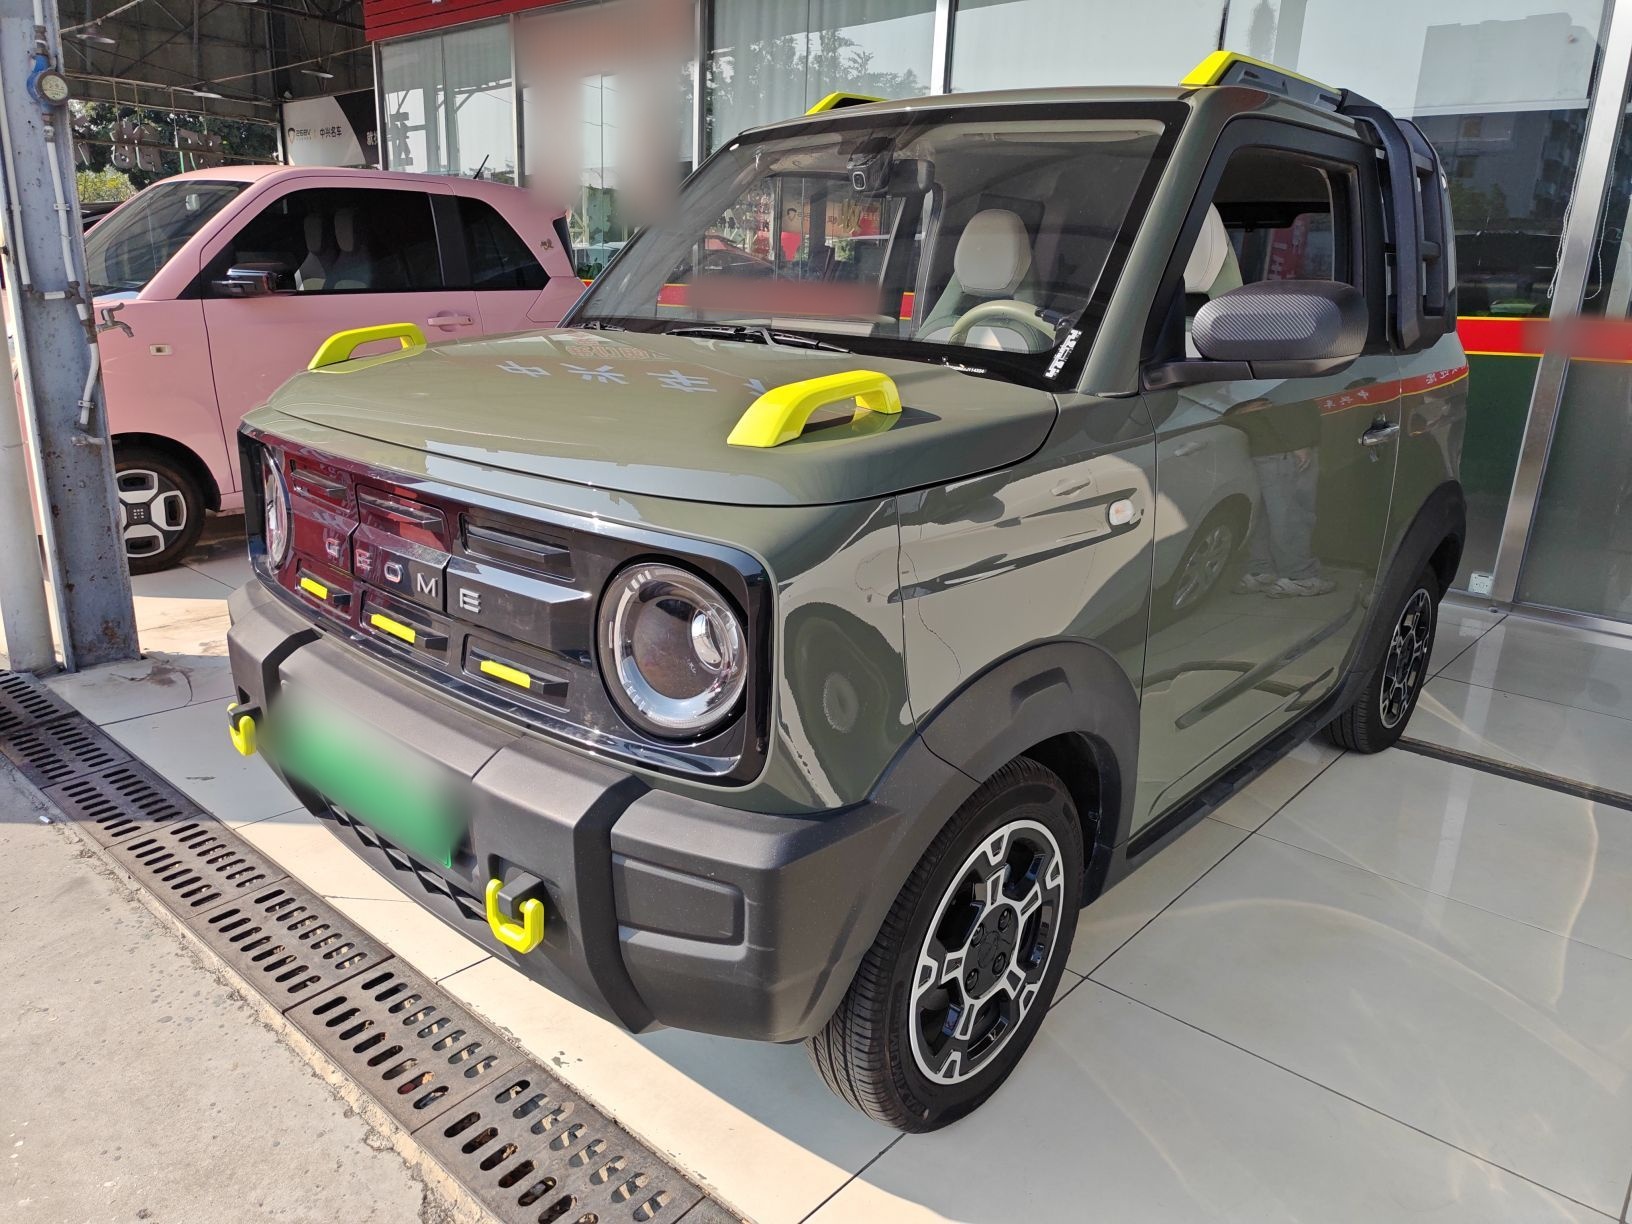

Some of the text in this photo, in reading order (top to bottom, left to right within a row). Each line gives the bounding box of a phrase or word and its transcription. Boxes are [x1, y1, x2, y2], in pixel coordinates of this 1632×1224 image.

[319, 126, 342, 138] 中兴名车
[325, 537, 481, 614] GEOME
